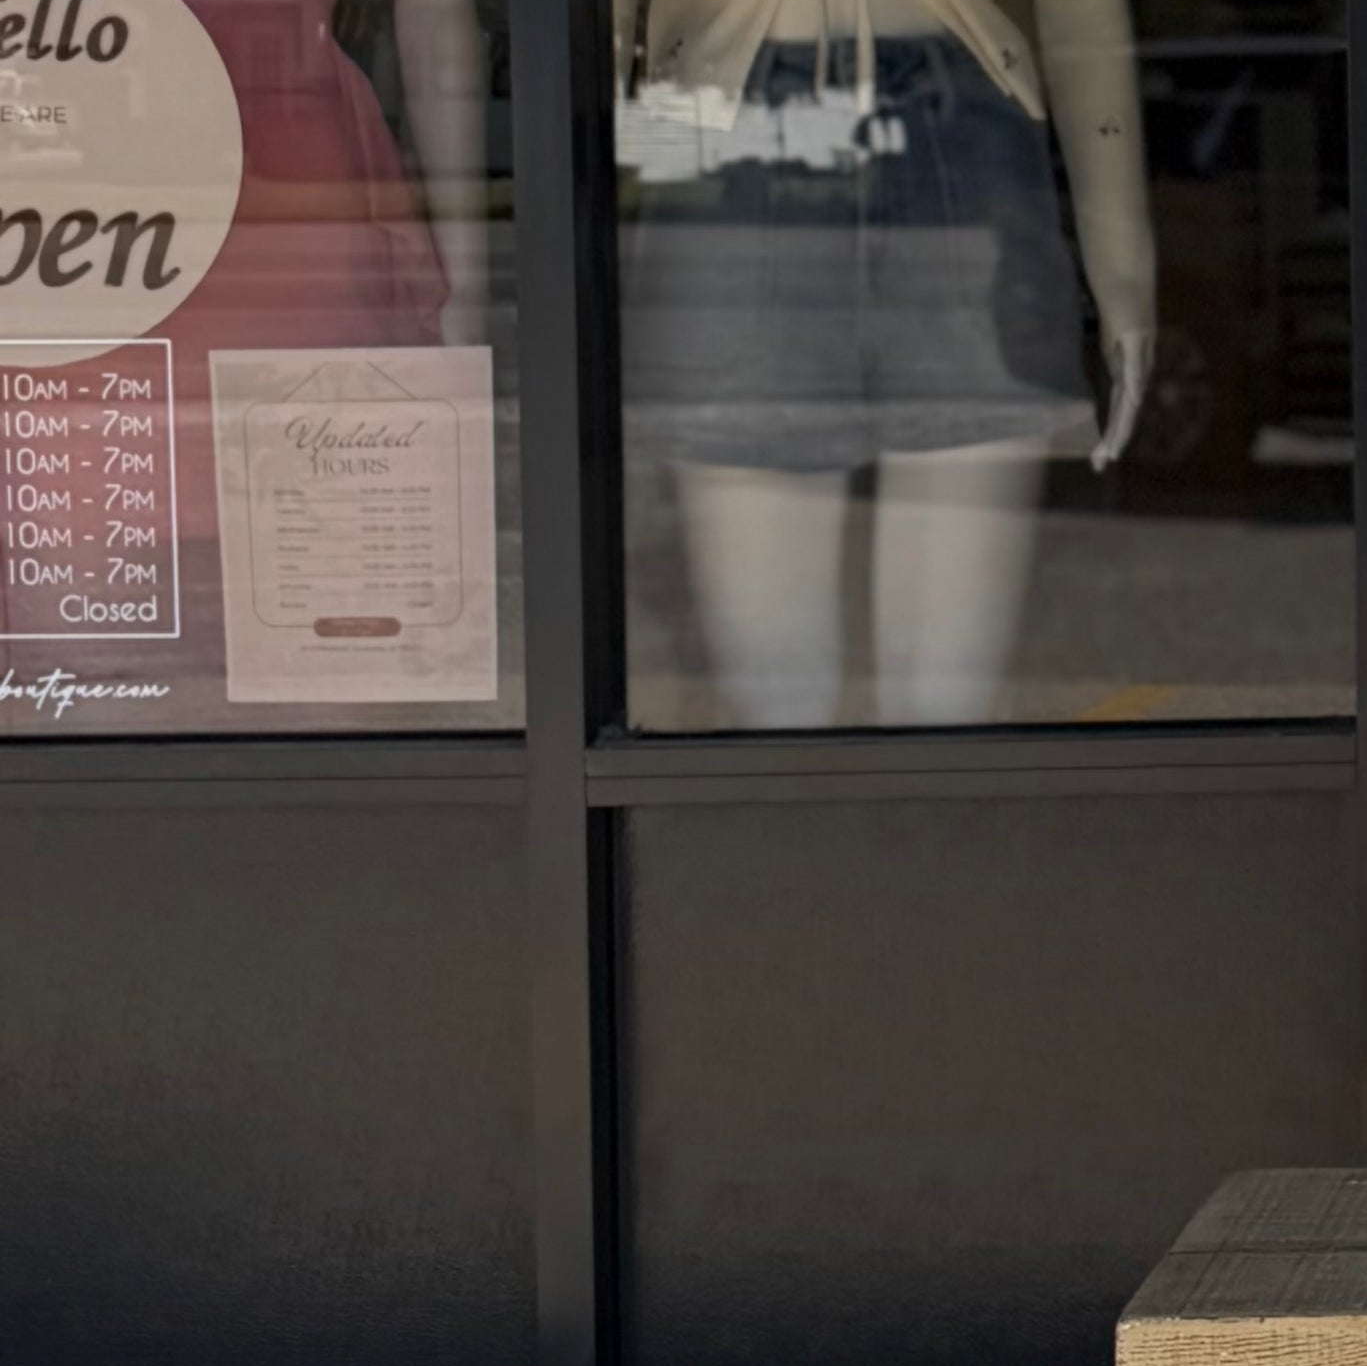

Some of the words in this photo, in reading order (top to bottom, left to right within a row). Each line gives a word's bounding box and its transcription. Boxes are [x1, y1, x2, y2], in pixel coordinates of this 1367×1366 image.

[19, 106, 67, 124] ARE
[3, 374, 67, 401] 10AM
[102, 372, 151, 400] 7PM
[4, 410, 68, 438] 10AM
[103, 410, 152, 437] 7PM
[285, 417, 425, 462] Updated
[5, 447, 69, 475] 10AM
[104, 447, 153, 474] 7PM
[312, 458, 390, 475] HOURS
[7, 484, 71, 512] 10AM
[105, 484, 154, 511] 7PM
[8, 521, 72, 549] 10AM
[106, 521, 155, 548] 7PM
[9, 558, 73, 585] 10AM
[107, 558, 157, 585] 7PM
[59, 594, 158, 622] Closed
